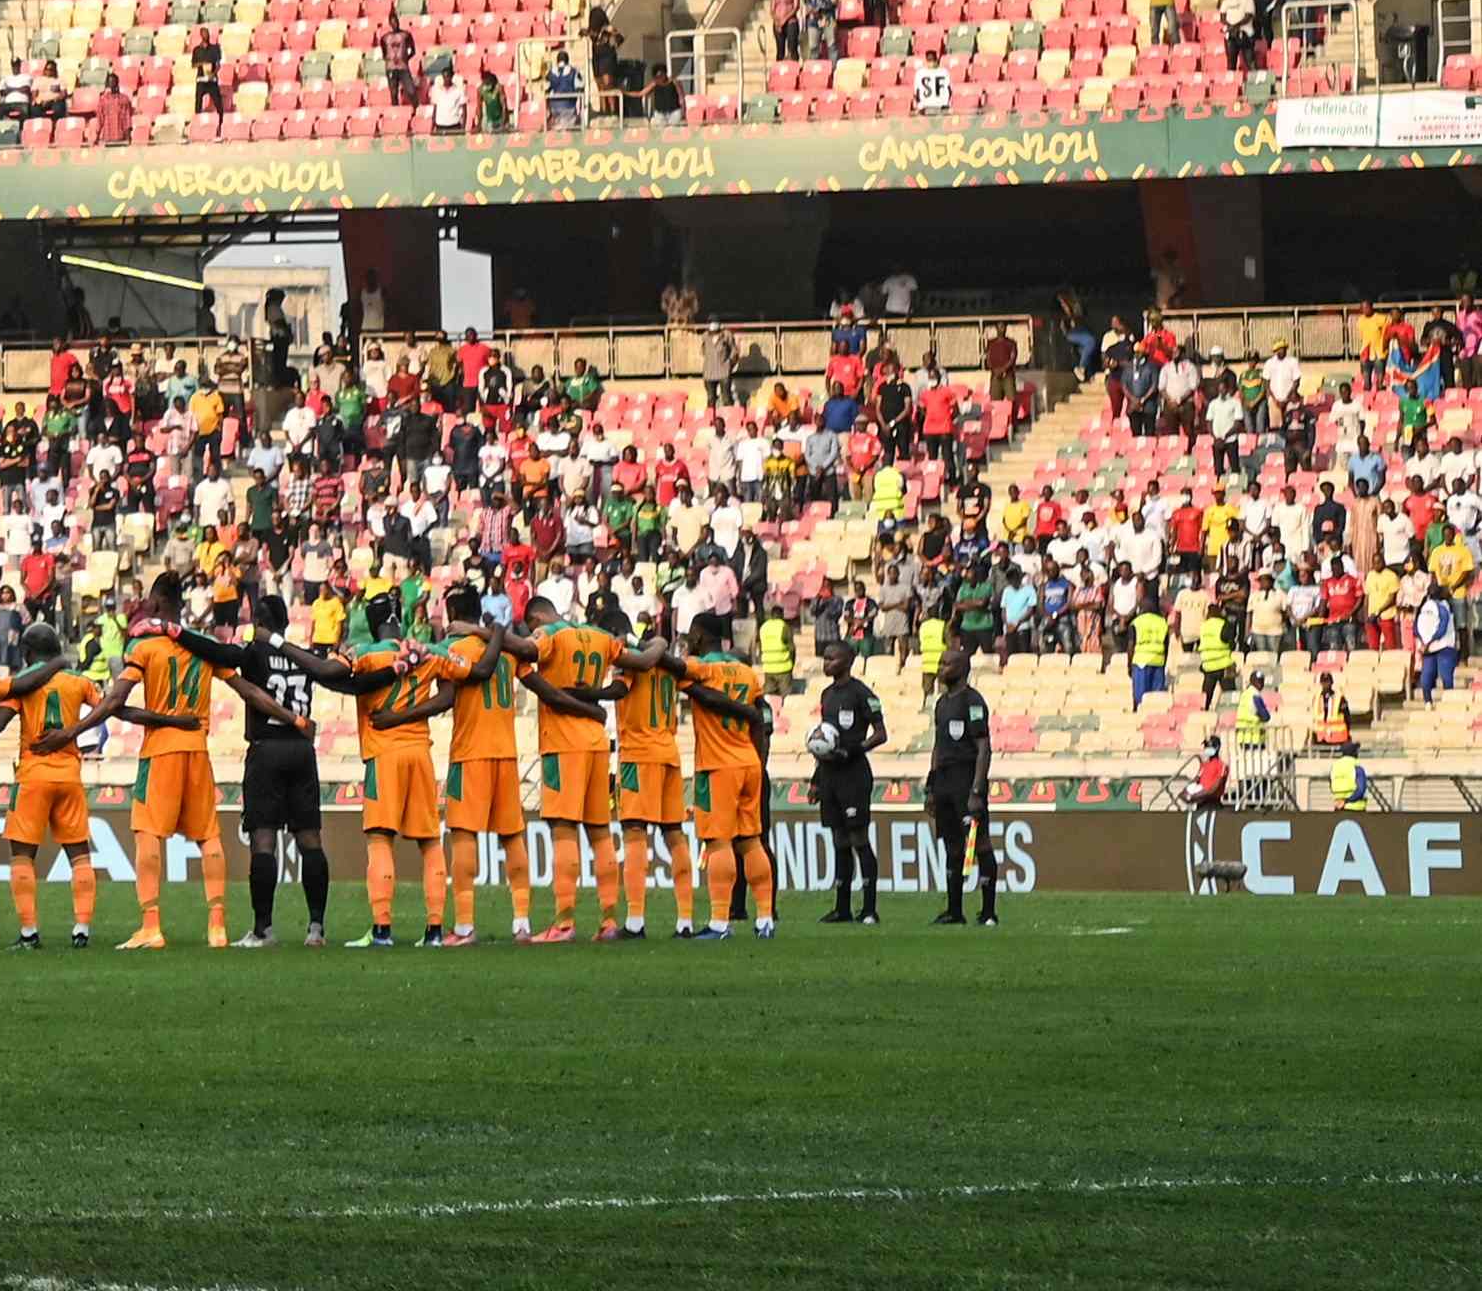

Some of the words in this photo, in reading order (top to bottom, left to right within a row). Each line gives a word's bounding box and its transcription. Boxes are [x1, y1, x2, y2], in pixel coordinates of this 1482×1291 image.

[167, 655, 205, 710] 14
[265, 673, 311, 726] 23
[1240, 819, 1463, 897] CAF
